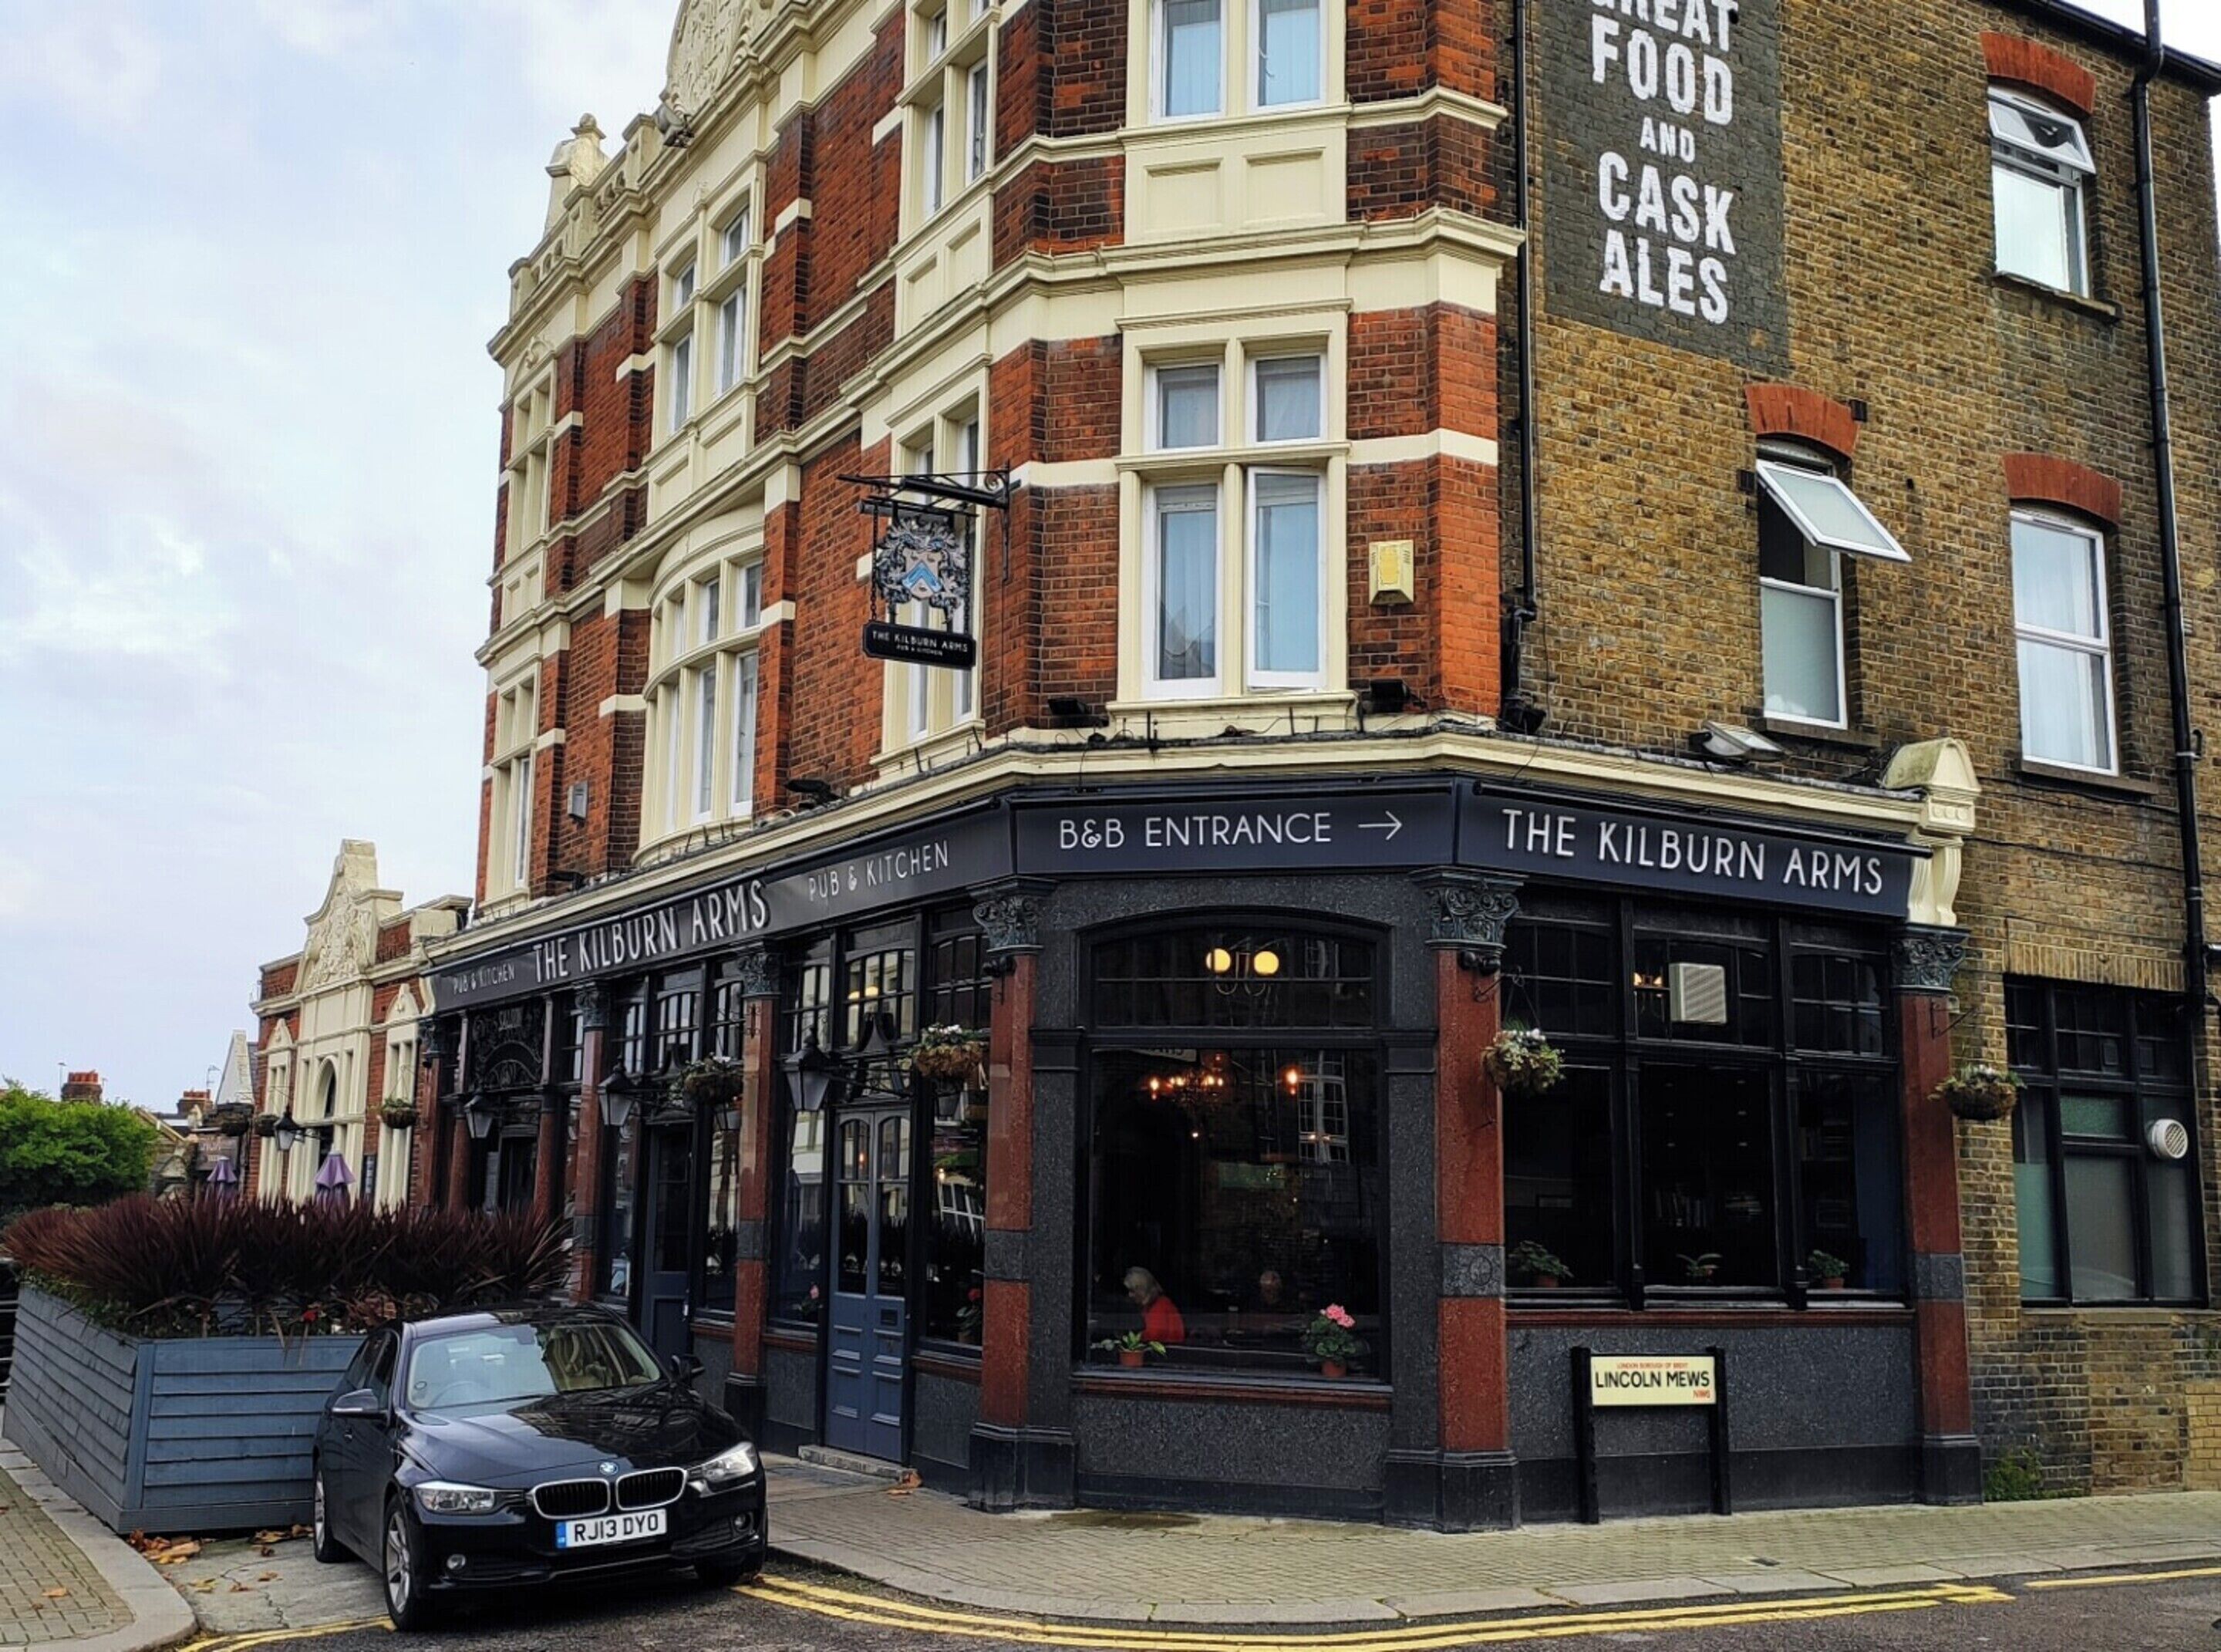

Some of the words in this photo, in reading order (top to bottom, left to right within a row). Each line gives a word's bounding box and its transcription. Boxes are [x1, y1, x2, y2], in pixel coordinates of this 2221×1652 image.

[1592, 15, 1733, 126] FOOD
[1640, 117, 1696, 163] AND
[1599, 152, 1736, 255] CASK
[1599, 230, 1728, 325] ALES
[872, 630, 889, 642] THE
[895, 633, 937, 648] KILBURN
[942, 642, 968, 652] ARMS
[1060, 818, 1124, 848] B&B
[1145, 812, 1331, 847] ENTRANCE
[1502, 808, 1576, 857] THE
[1597, 821, 1764, 881] KILBURN
[1783, 848, 1882, 895] ARMS
[808, 871, 839, 902] PUB
[848, 865, 858, 892] &
[866, 840, 948, 887] KITCHEN
[532, 938, 568, 983] THE
[578, 907, 679, 972] KILBURN
[692, 880, 769, 945] ARMS
[453, 974, 469, 995] PUB
[479, 963, 514, 987] KITCHEN
[1595, 1371, 1662, 1387] LINCOLN
[1667, 1370, 1710, 1387] MEWS
[574, 1519, 617, 1542] RJ13
[622, 1513, 659, 1535] DYO
